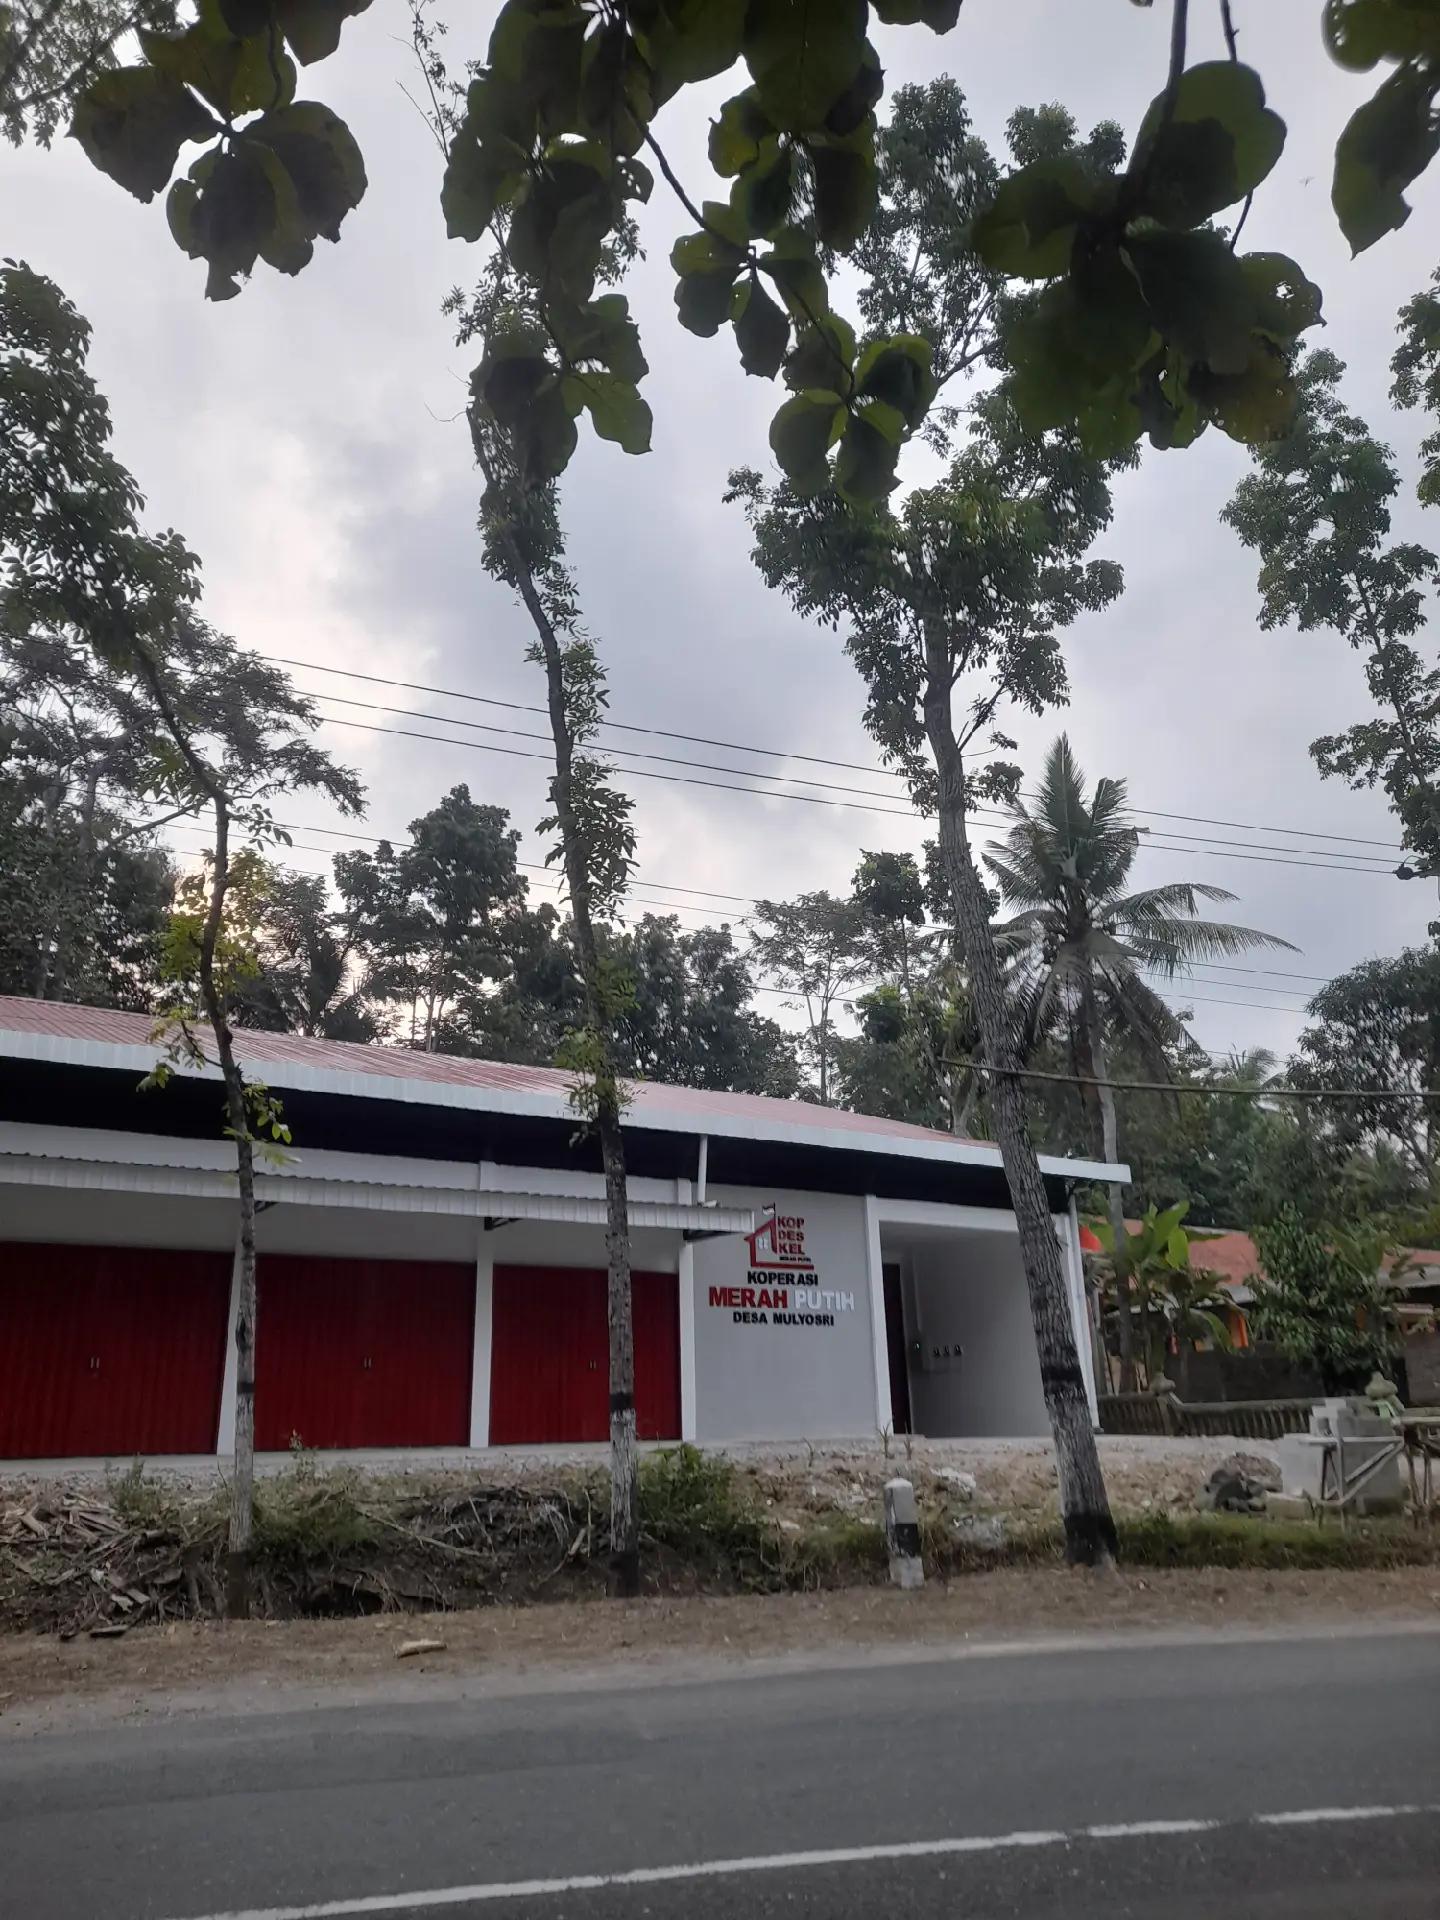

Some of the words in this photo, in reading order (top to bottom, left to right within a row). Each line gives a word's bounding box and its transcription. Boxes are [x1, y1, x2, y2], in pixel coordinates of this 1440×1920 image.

[778, 1216, 804, 1228] KOP
[778, 1231, 804, 1241] DES
[779, 1244, 805, 1255] KEL
[747, 1271, 818, 1286] KOPERASI
[709, 1286, 788, 1308] MERAH
[795, 1290, 855, 1311] PUTIH
[733, 1311, 767, 1324] DESA
